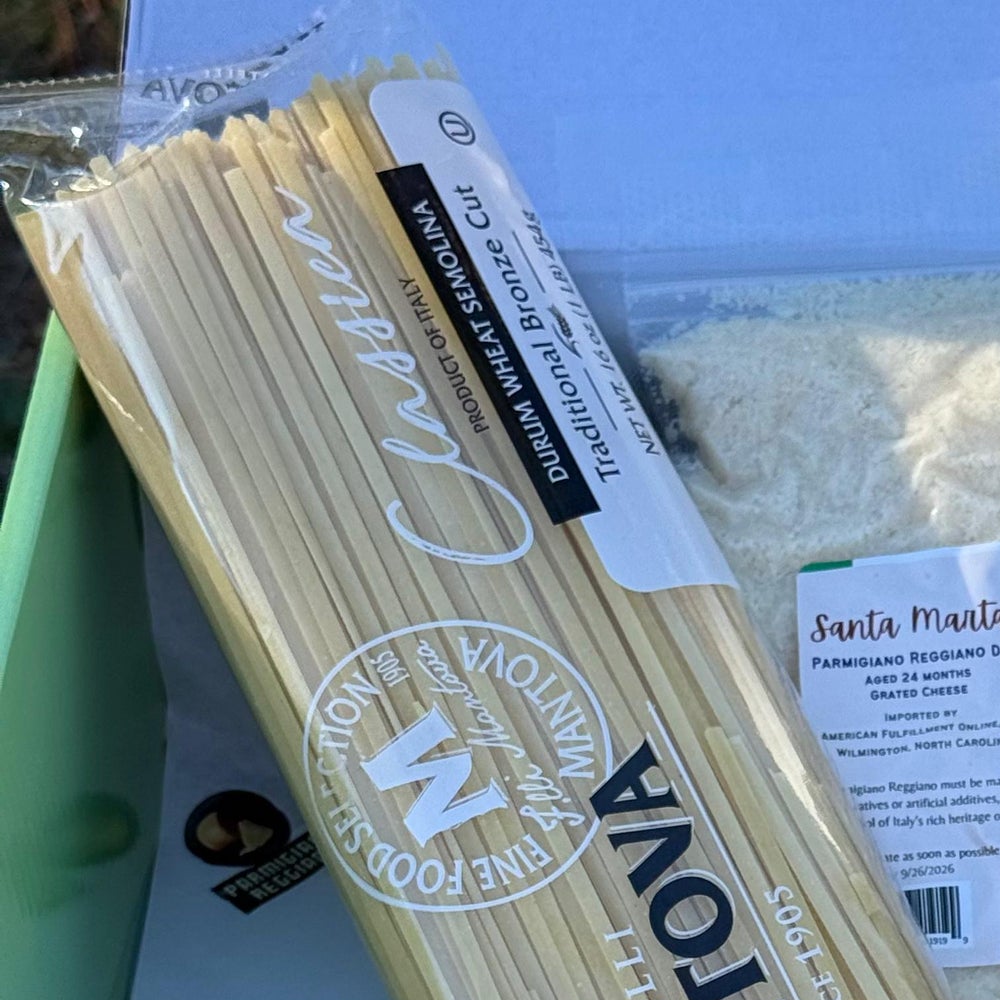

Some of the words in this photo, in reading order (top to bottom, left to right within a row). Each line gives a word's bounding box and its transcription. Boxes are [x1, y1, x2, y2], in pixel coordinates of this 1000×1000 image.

[453, 184, 491, 230] Cut
[411, 199, 485, 315] SEMOLINA
[399, 277, 432, 322] ITALY
[486, 238, 545, 333] Bronze
[424, 326, 447, 350] OF
[470, 317, 524, 401] WHEAT
[592, 349, 615, 372] 16
[273, 185, 534, 565] Classica
[439, 353, 489, 434] PRODUCT
[533, 342, 623, 484] Traditional
[629, 417, 662, 456] NET
[513, 401, 570, 484] DURUM
[810, 609, 901, 643] Santa
[368, 650, 412, 688] 1905
[901, 672, 919, 683] 24
[458, 636, 595, 779] MANTOVA
[360, 700, 509, 849] M
[889, 781, 938, 794] Reggiano
[940, 780, 966, 789] must
[970, 778, 983, 788] be
[878, 817, 890, 827] of
[926, 815, 945, 826] rich
[949, 812, 990, 826] heritage
[891, 802, 902, 810] or
[906, 798, 948, 809] artificial
[950, 795, 1000, 807] additives,
[223, 833, 318, 899] PARMIGIA
[253, 850, 323, 901] REGGIA
[366, 841, 465, 896] FOOD
[471, 833, 554, 891] FINE
[900, 865, 955, 880] 9/26/2026
[902, 854, 914, 862] as
[917, 850, 942, 861] soon
[944, 851, 956, 859] as
[959, 846, 1000, 859] possible
[763, 884, 825, 965] 1905
